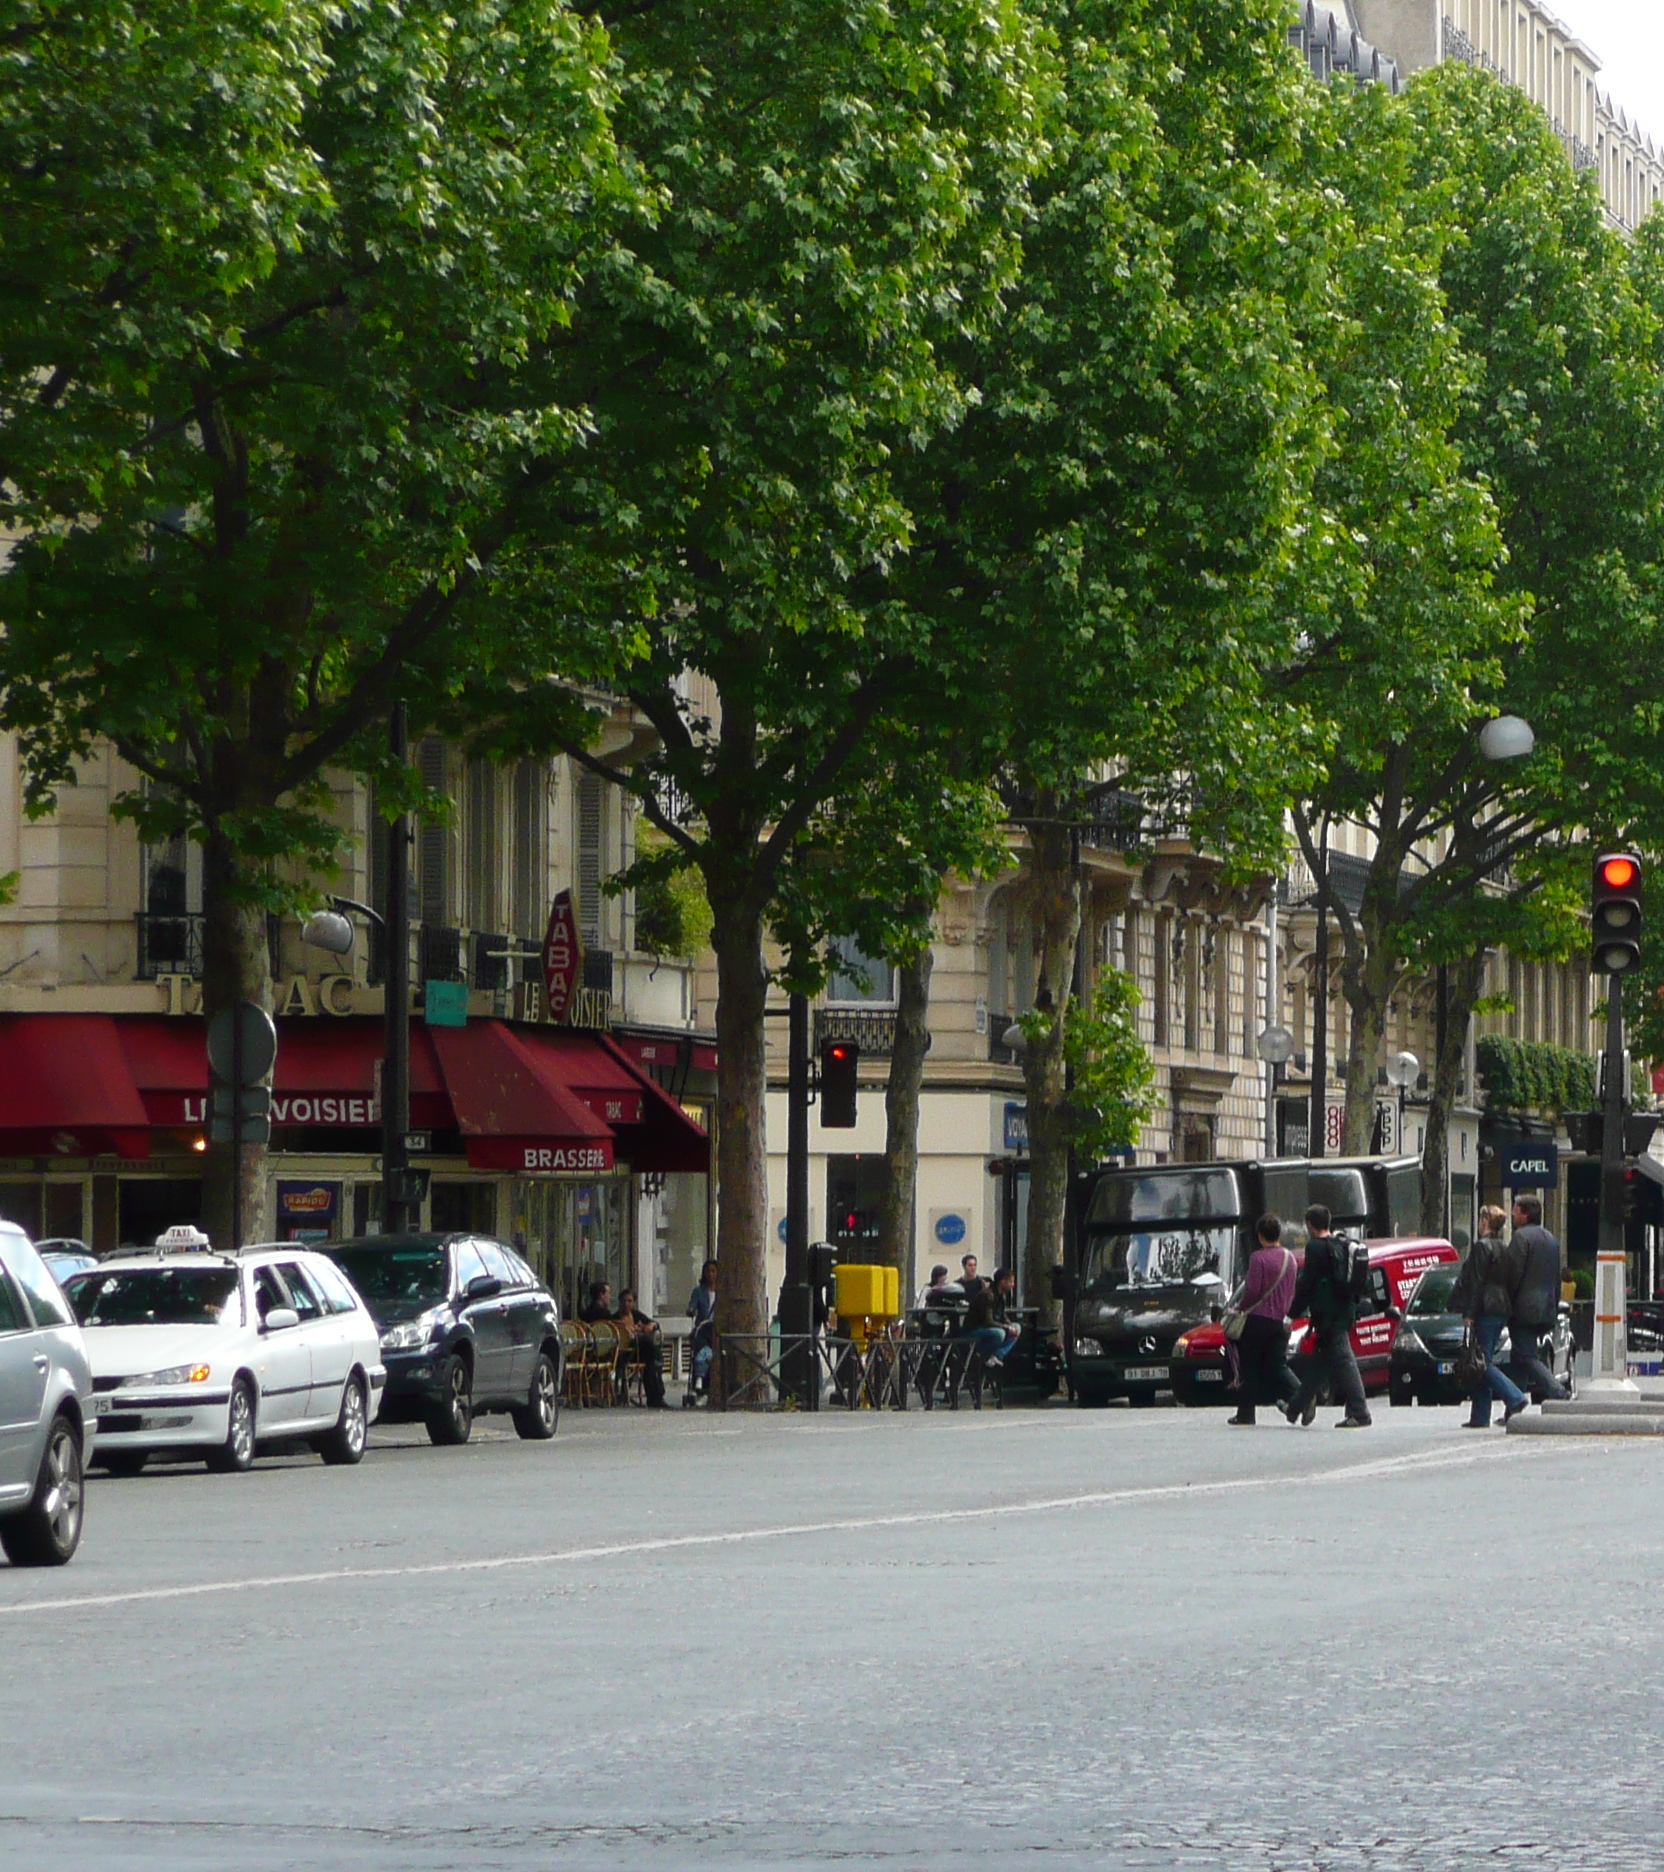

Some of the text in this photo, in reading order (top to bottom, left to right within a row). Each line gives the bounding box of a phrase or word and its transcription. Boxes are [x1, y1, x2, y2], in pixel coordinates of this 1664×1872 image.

[548, 904, 571, 1011] TABAC
[155, 973, 354, 1017] TAC
[270, 1098, 375, 1123] VOISIE
[1510, 1159, 1550, 1173] CAPEL
[171, 1228, 191, 1238] TAXI
